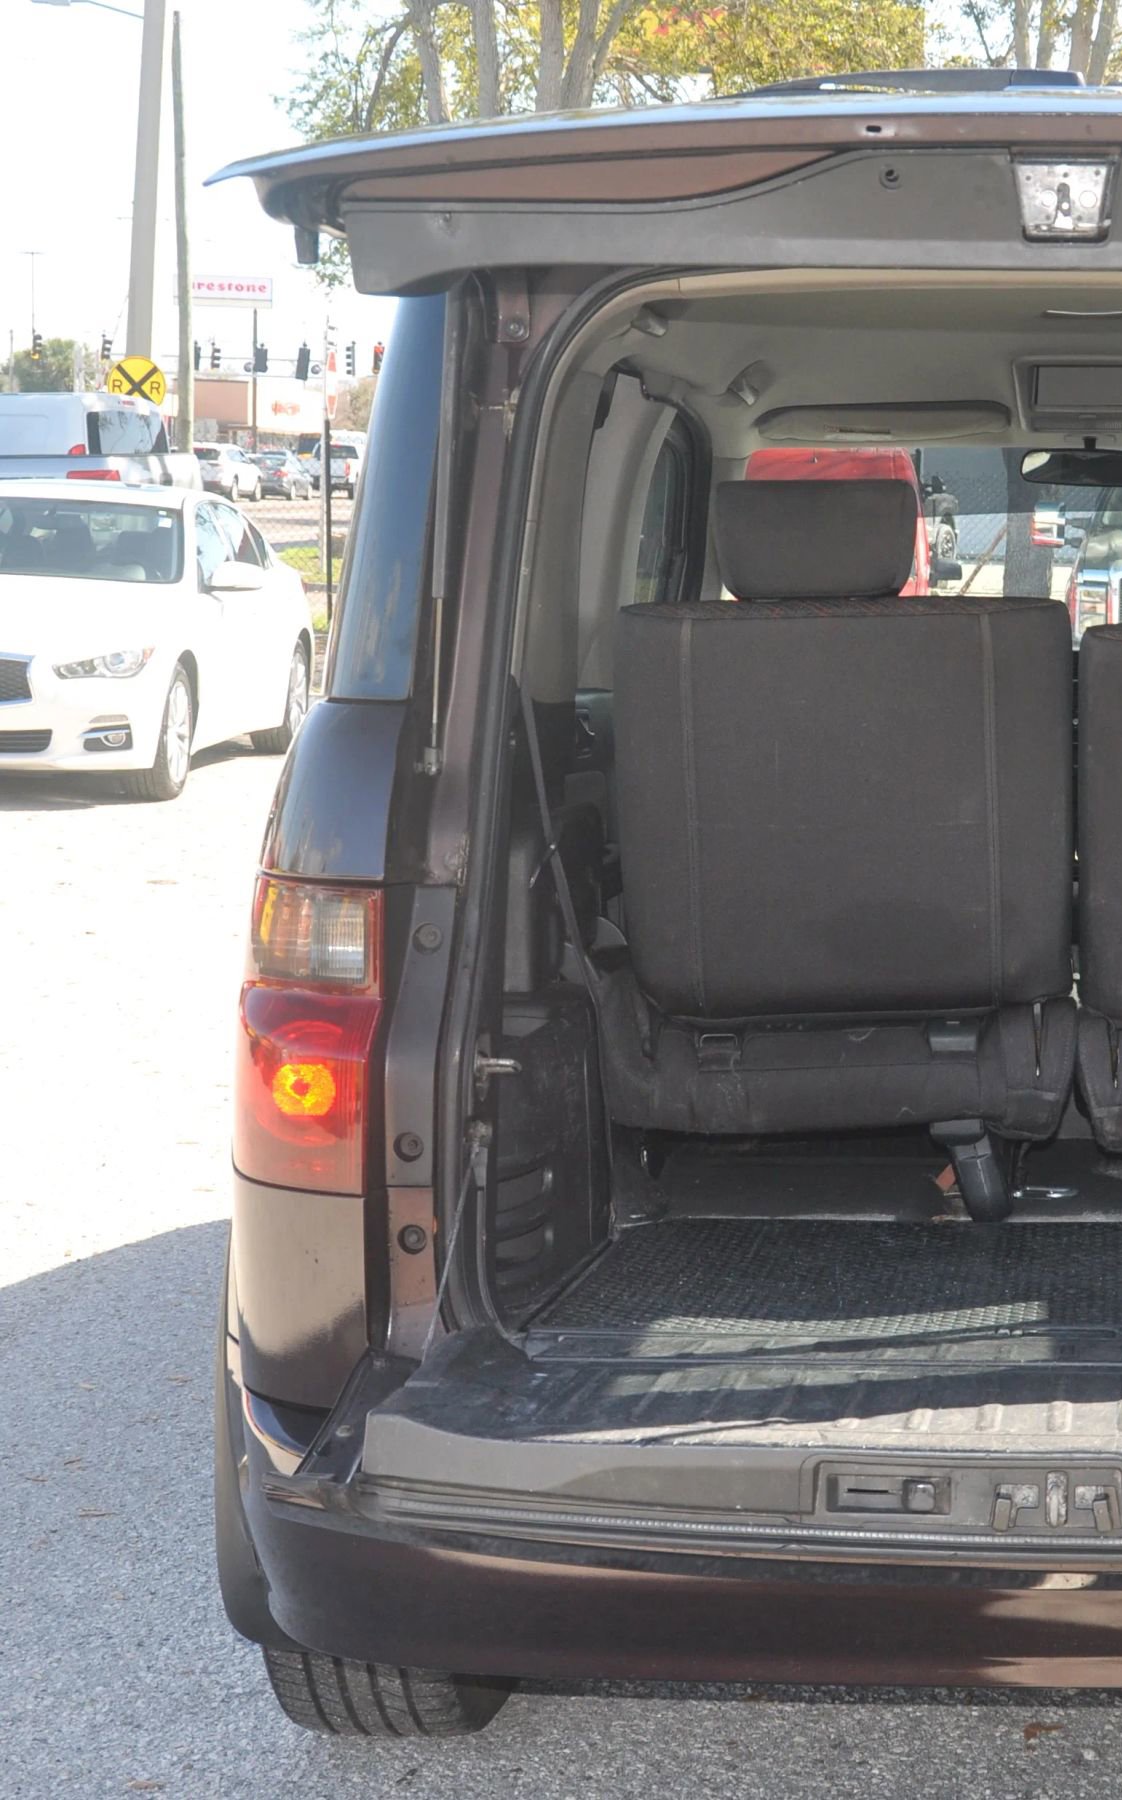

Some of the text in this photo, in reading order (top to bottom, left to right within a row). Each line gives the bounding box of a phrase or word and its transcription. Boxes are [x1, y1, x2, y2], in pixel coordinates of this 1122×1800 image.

[192, 281, 267, 293] irestone
[112, 379, 161, 395] R R
